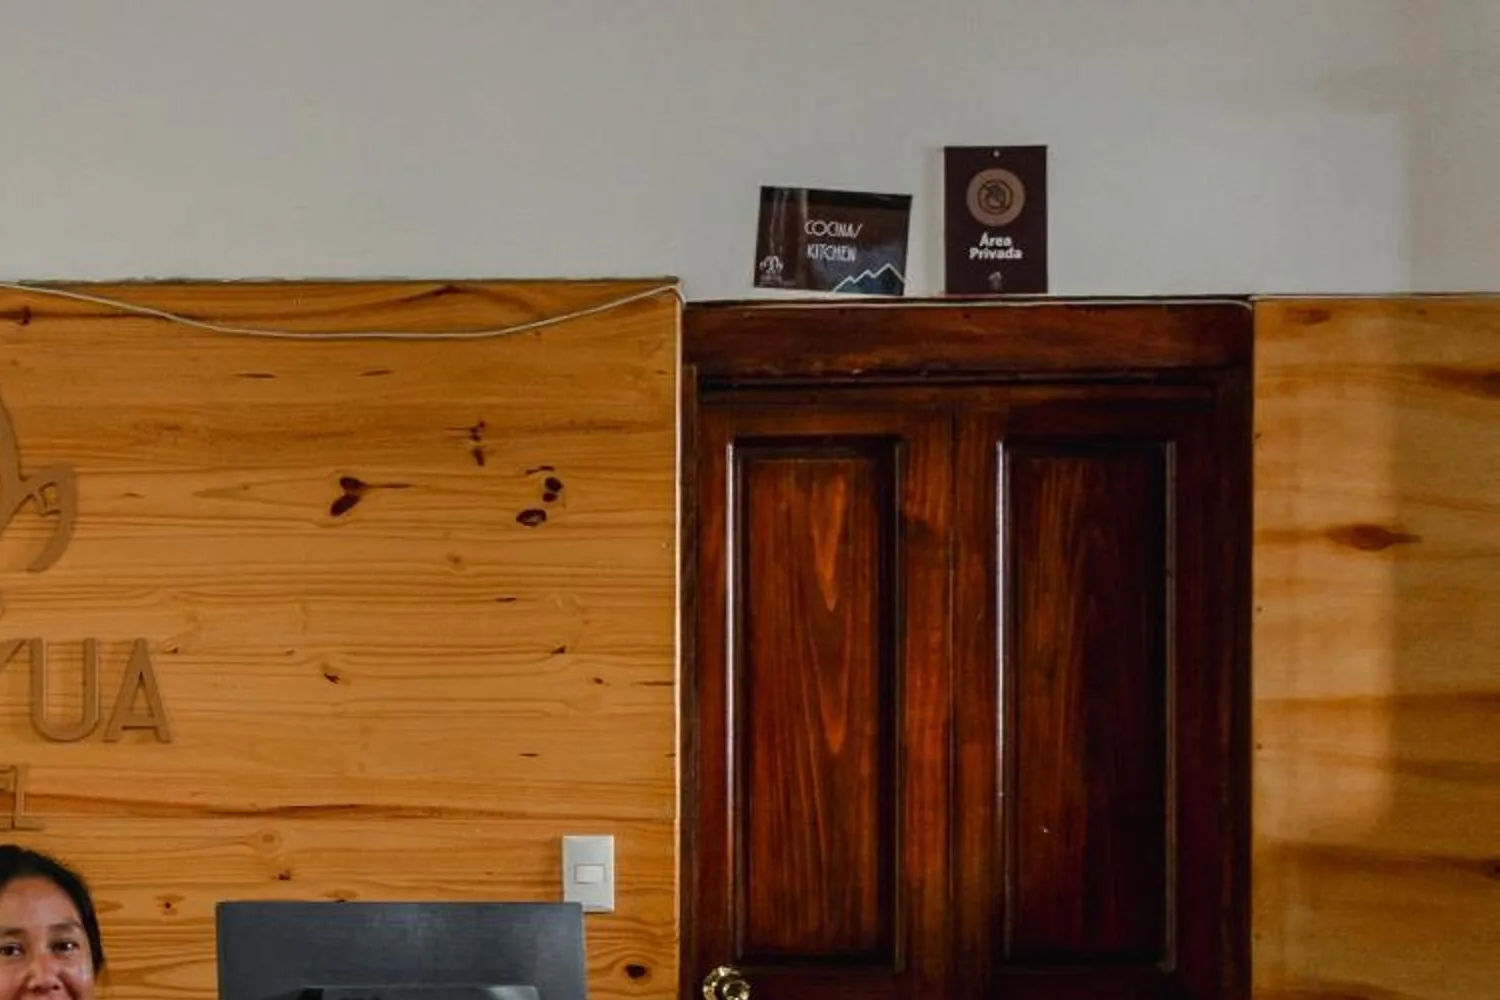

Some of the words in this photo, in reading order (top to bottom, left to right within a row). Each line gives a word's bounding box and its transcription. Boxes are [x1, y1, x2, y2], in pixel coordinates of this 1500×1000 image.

[979, 232, 1012, 247] Área
[806, 243, 857, 263] KITCHEN
[969, 248, 1023, 260] Privada
